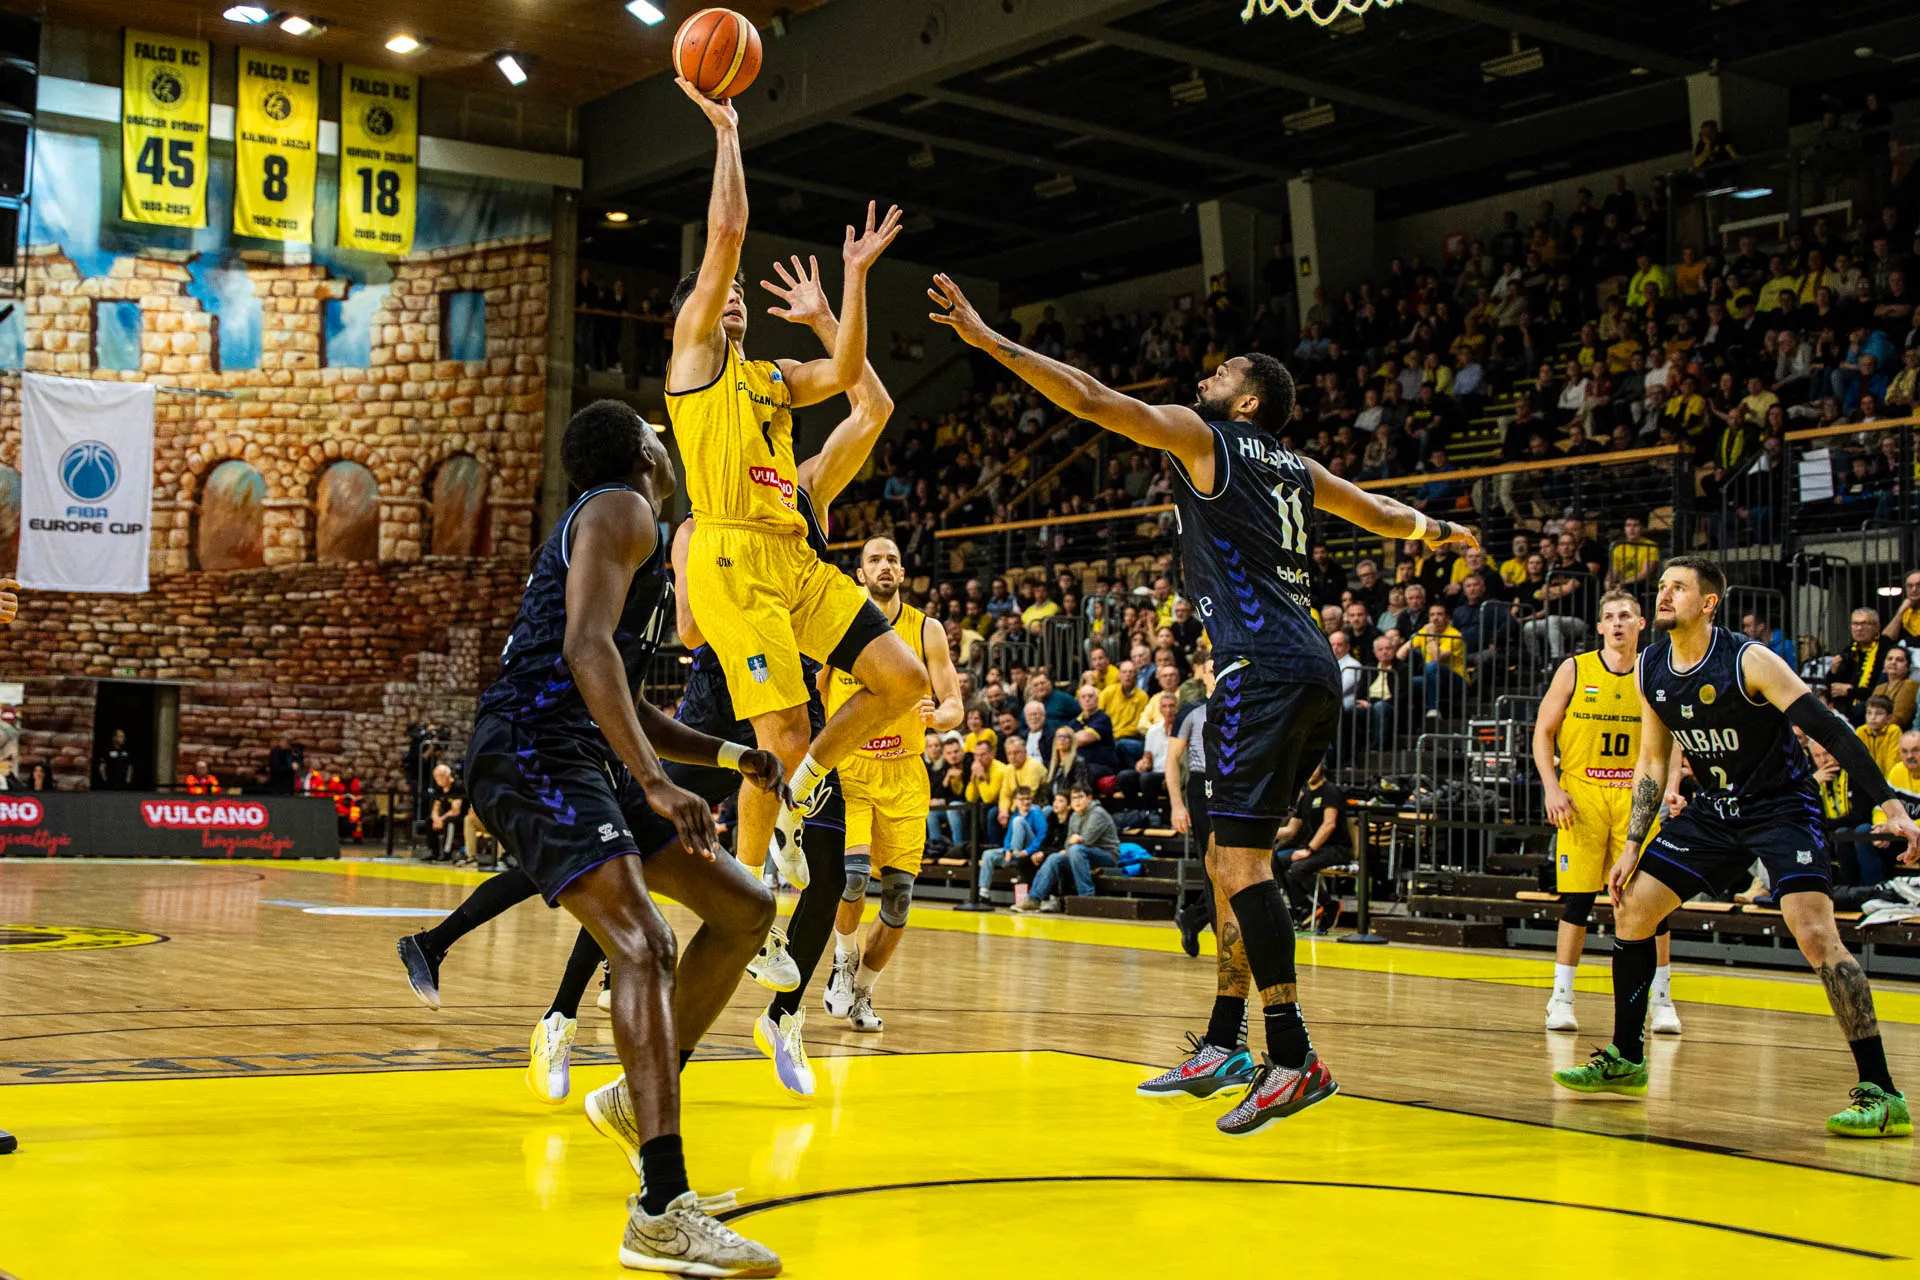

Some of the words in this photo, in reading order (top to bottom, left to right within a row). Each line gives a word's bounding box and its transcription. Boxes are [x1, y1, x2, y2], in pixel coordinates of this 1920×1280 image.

[134, 42, 177, 64] FALCO
[182, 48, 201, 67] KC
[247, 60, 287, 82] FALCO
[292, 66, 310, 85] KC
[350, 77, 389, 97] FALCO
[394, 82, 411, 101] KC
[136, 136, 195, 189] 45
[263, 155, 288, 202] 8
[357, 167, 400, 216] 18
[751, 469, 793, 495] VULNO
[66, 505, 108, 519] FIBA
[1271, 482, 1308, 555] 11
[29, 518, 104, 534] EUROPE
[109, 522, 143, 535] CUP
[1573, 712, 1620, 722] FALCO-VULCANO
[1600, 732, 1630, 757] 10
[1587, 768, 1634, 779] VULCANO
[1709, 766, 1734, 791] 2
[145, 805, 264, 825] VULCANO
